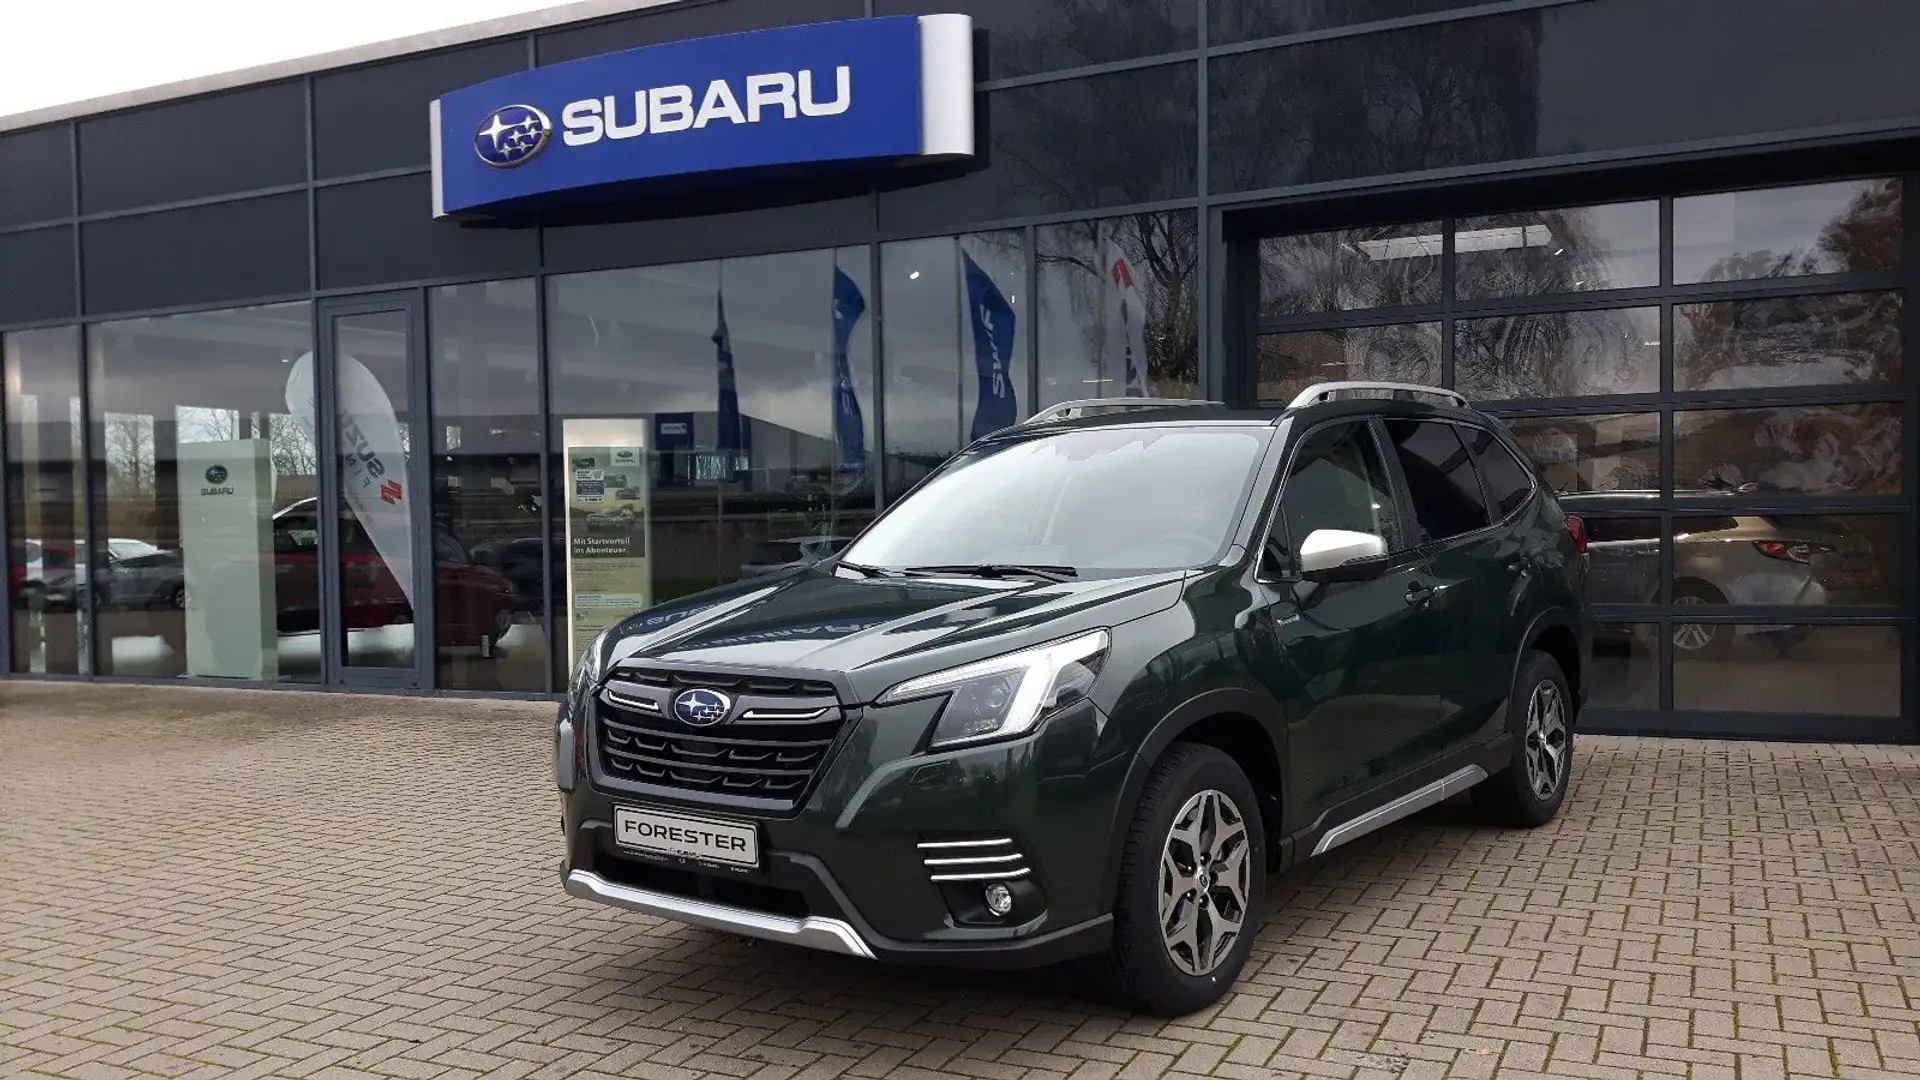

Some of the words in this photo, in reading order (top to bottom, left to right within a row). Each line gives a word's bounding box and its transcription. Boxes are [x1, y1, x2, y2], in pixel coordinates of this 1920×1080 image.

[562, 66, 851, 147] SUBARU
[573, 537, 586, 545] Mit
[587, 537, 630, 545] Startvorteil
[625, 820, 747, 852] FORESTER
